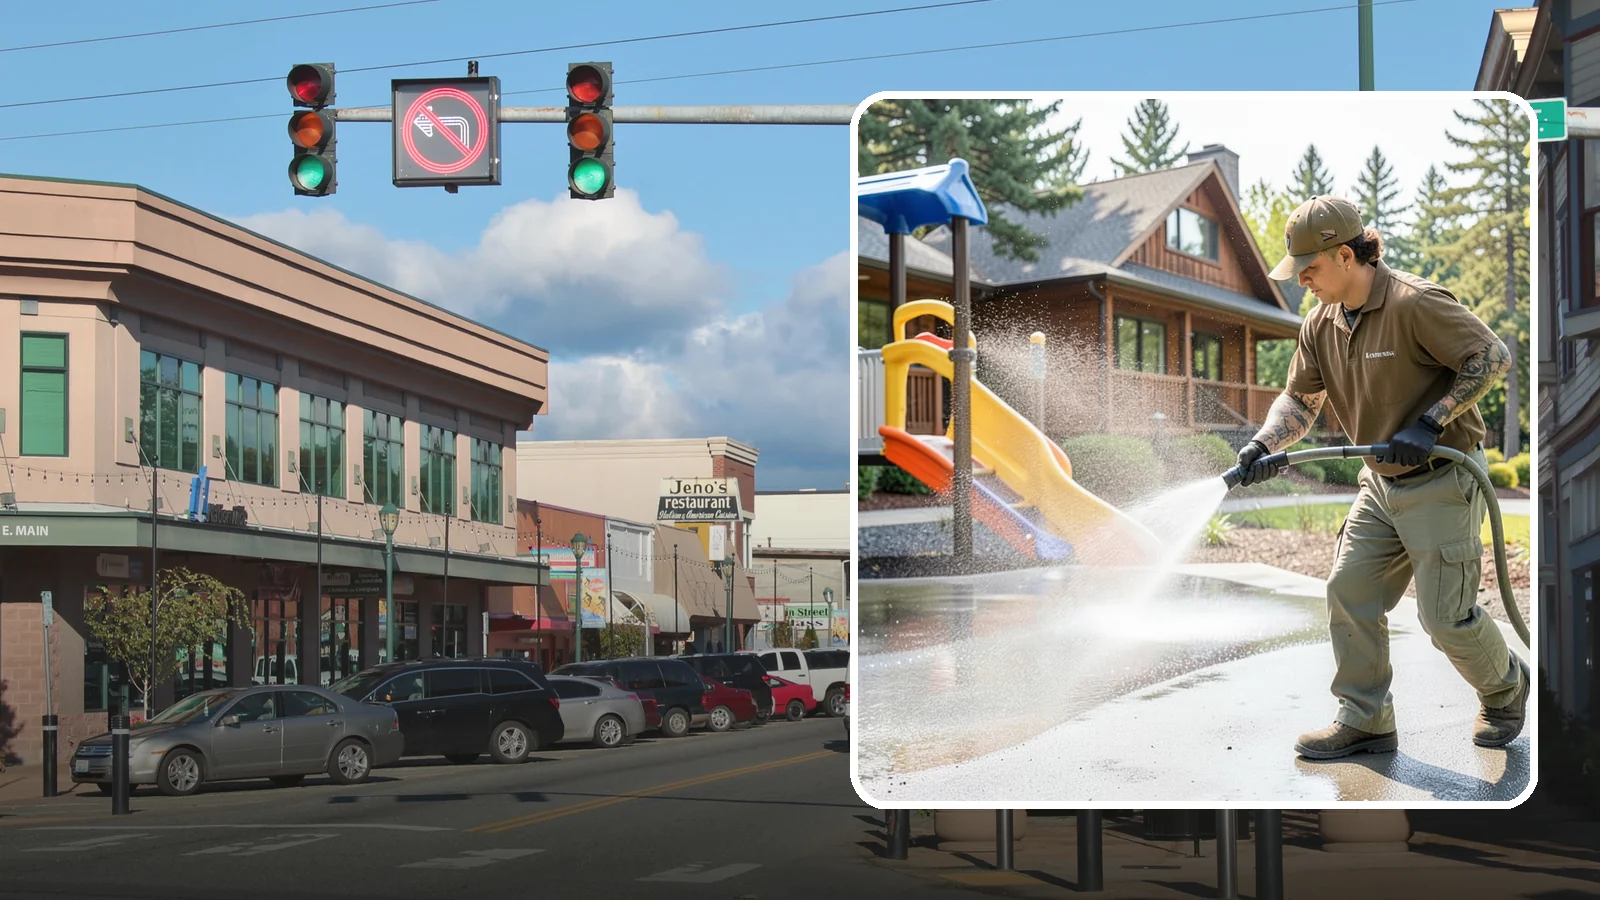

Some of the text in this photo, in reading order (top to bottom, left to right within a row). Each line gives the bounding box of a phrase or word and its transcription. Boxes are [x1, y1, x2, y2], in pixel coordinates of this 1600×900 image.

[670, 480, 727, 494] Jeno's
[664, 496, 731, 509] restaurant
[685, 509, 714, 519] American
[714, 509, 737, 519] Cuisine
[2, 525, 49, 536] E. MAIN
[798, 607, 828, 616] Street
